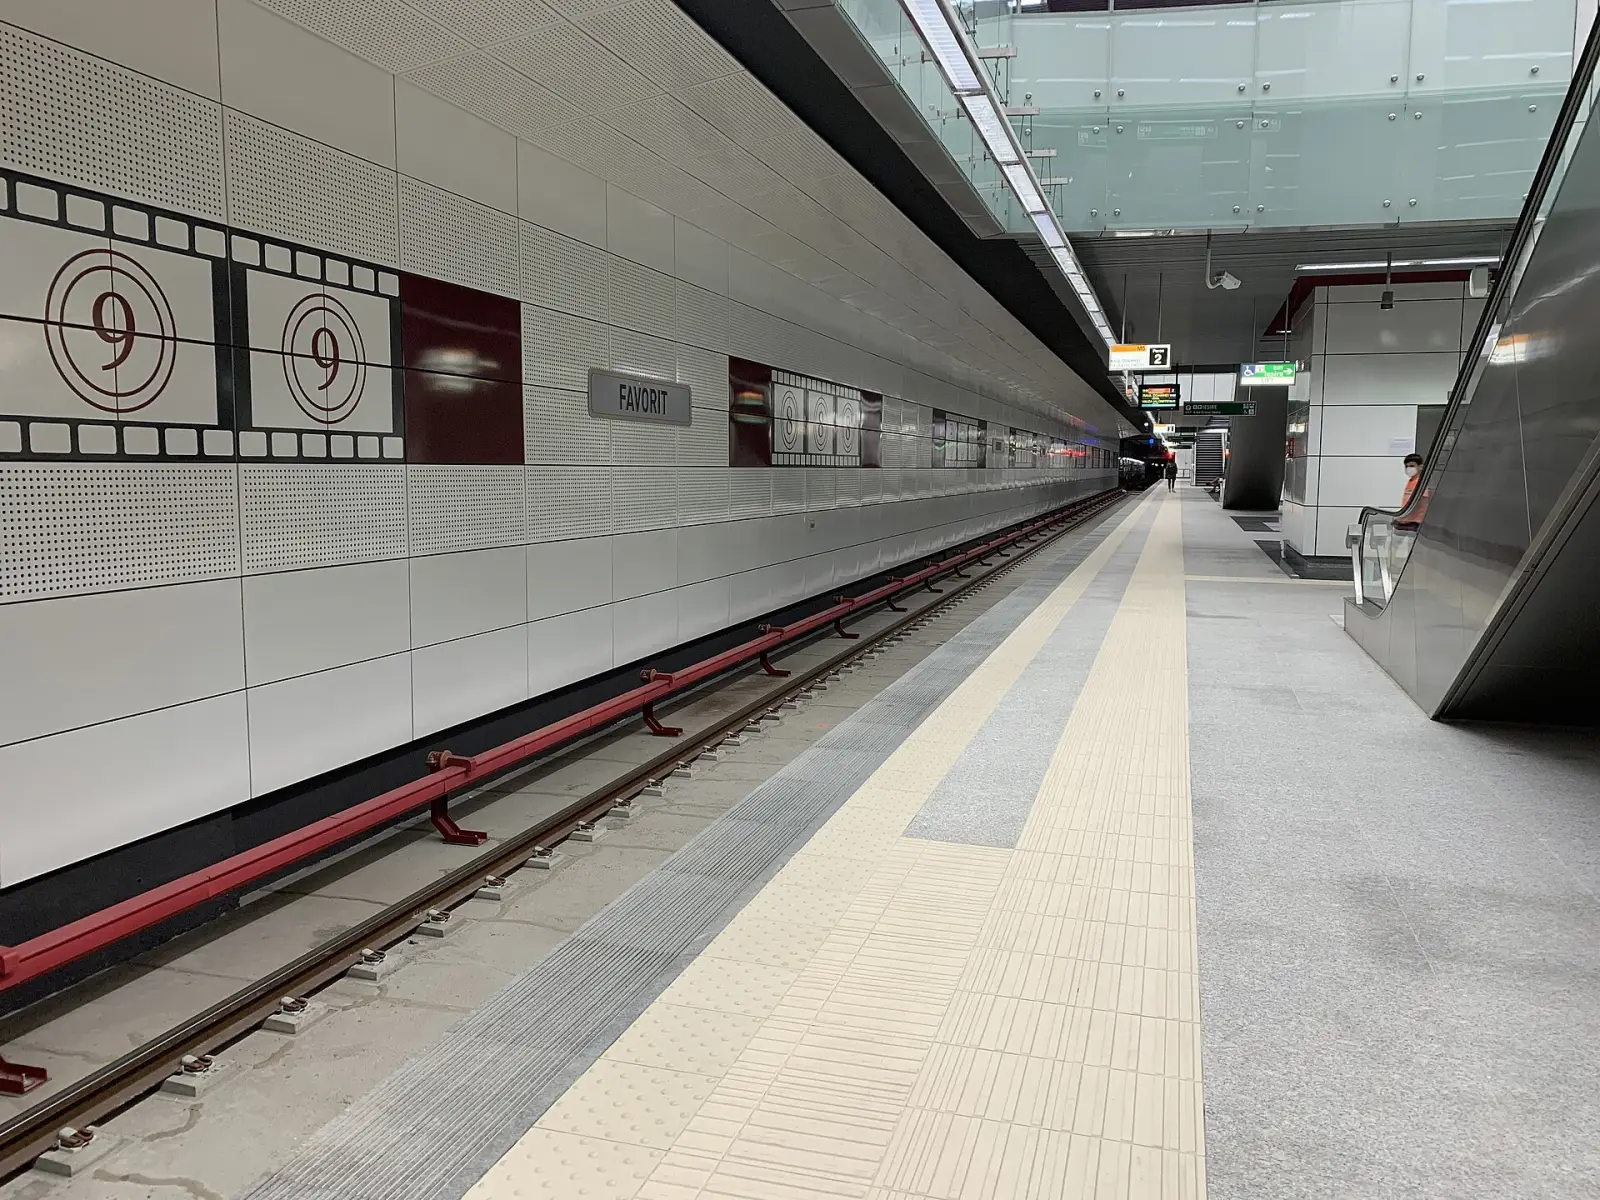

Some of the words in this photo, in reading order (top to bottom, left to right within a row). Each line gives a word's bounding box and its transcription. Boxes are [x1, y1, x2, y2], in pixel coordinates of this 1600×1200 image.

[92, 291, 135, 371] 9
[312, 327, 340, 391] 9
[1154, 353, 1162, 364] 2
[619, 383, 668, 415] FAVORIT
